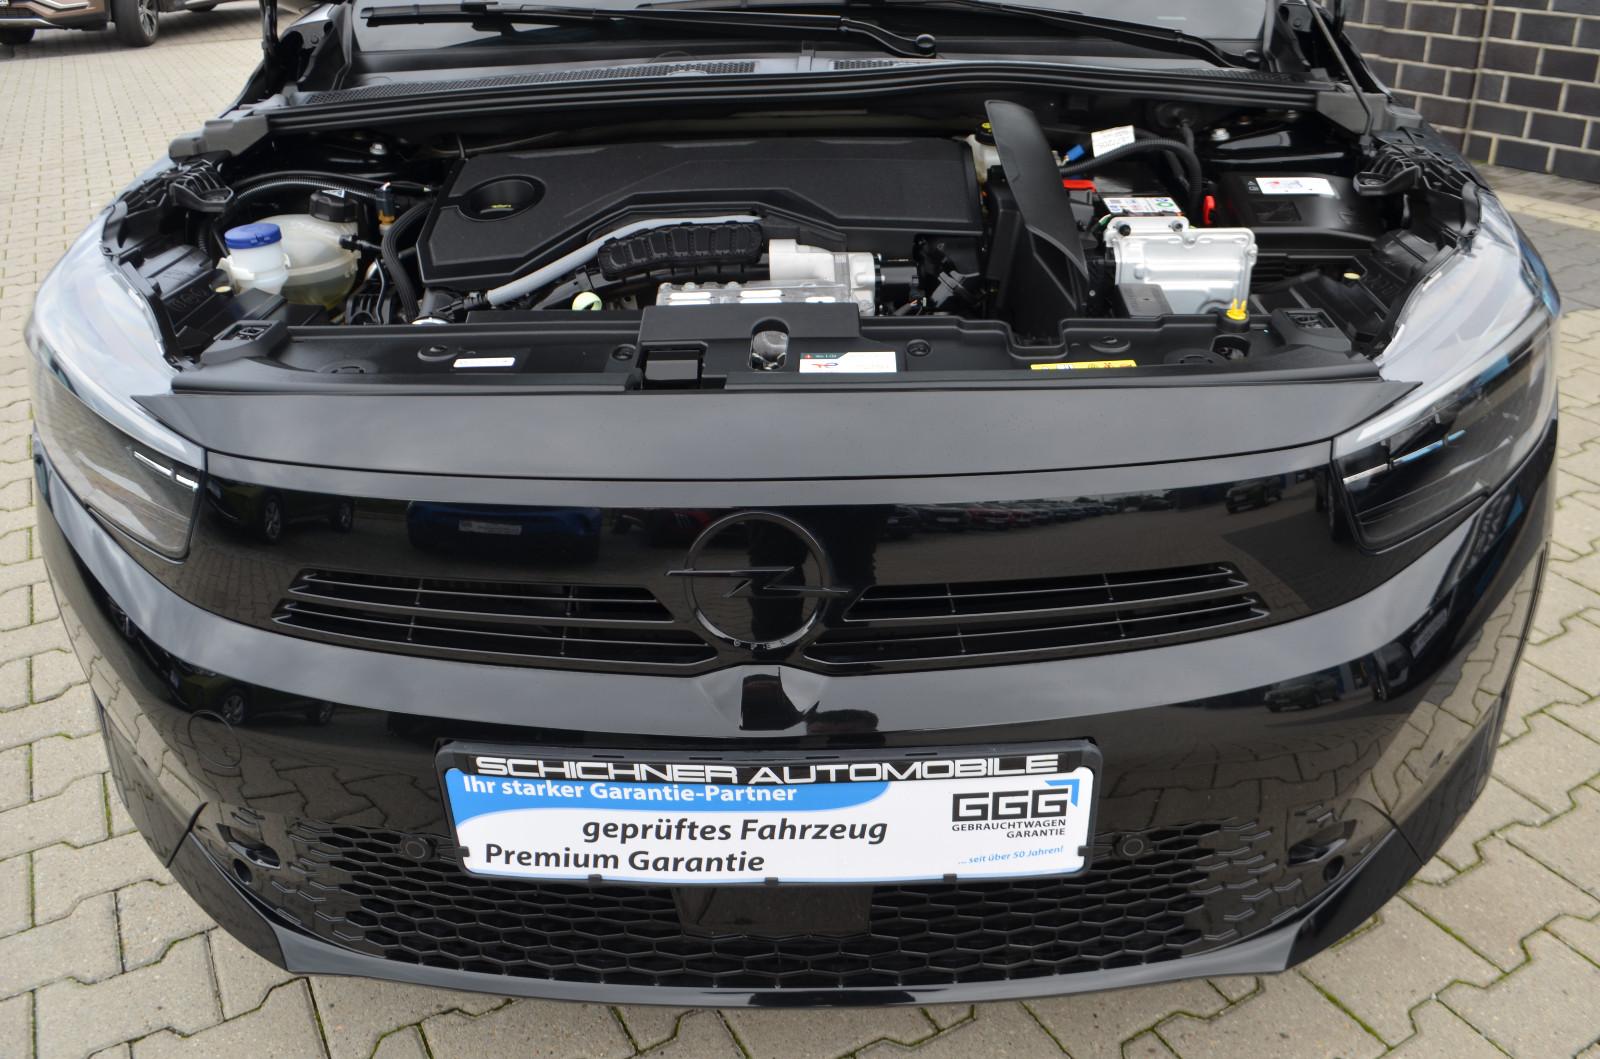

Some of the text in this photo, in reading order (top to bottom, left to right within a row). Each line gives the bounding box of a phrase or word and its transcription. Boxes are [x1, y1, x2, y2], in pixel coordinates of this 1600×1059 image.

[476, 754, 1058, 785] SCHICHNER AUTOMOBILE
[463, 775, 798, 802] Ihr starker Garantie-Partner
[952, 788, 1068, 822] GGG
[582, 817, 887, 845] geprüftes Fahrzeug
[952, 819, 1066, 832] GEBRAUCHTWAGEN
[1006, 828, 1065, 839] GARANTIE
[485, 843, 765, 873] Premium Garantie
[988, 852, 1010, 862] über
[1013, 850, 1025, 859] 50
[1027, 845, 1064, 857] Jahren!
